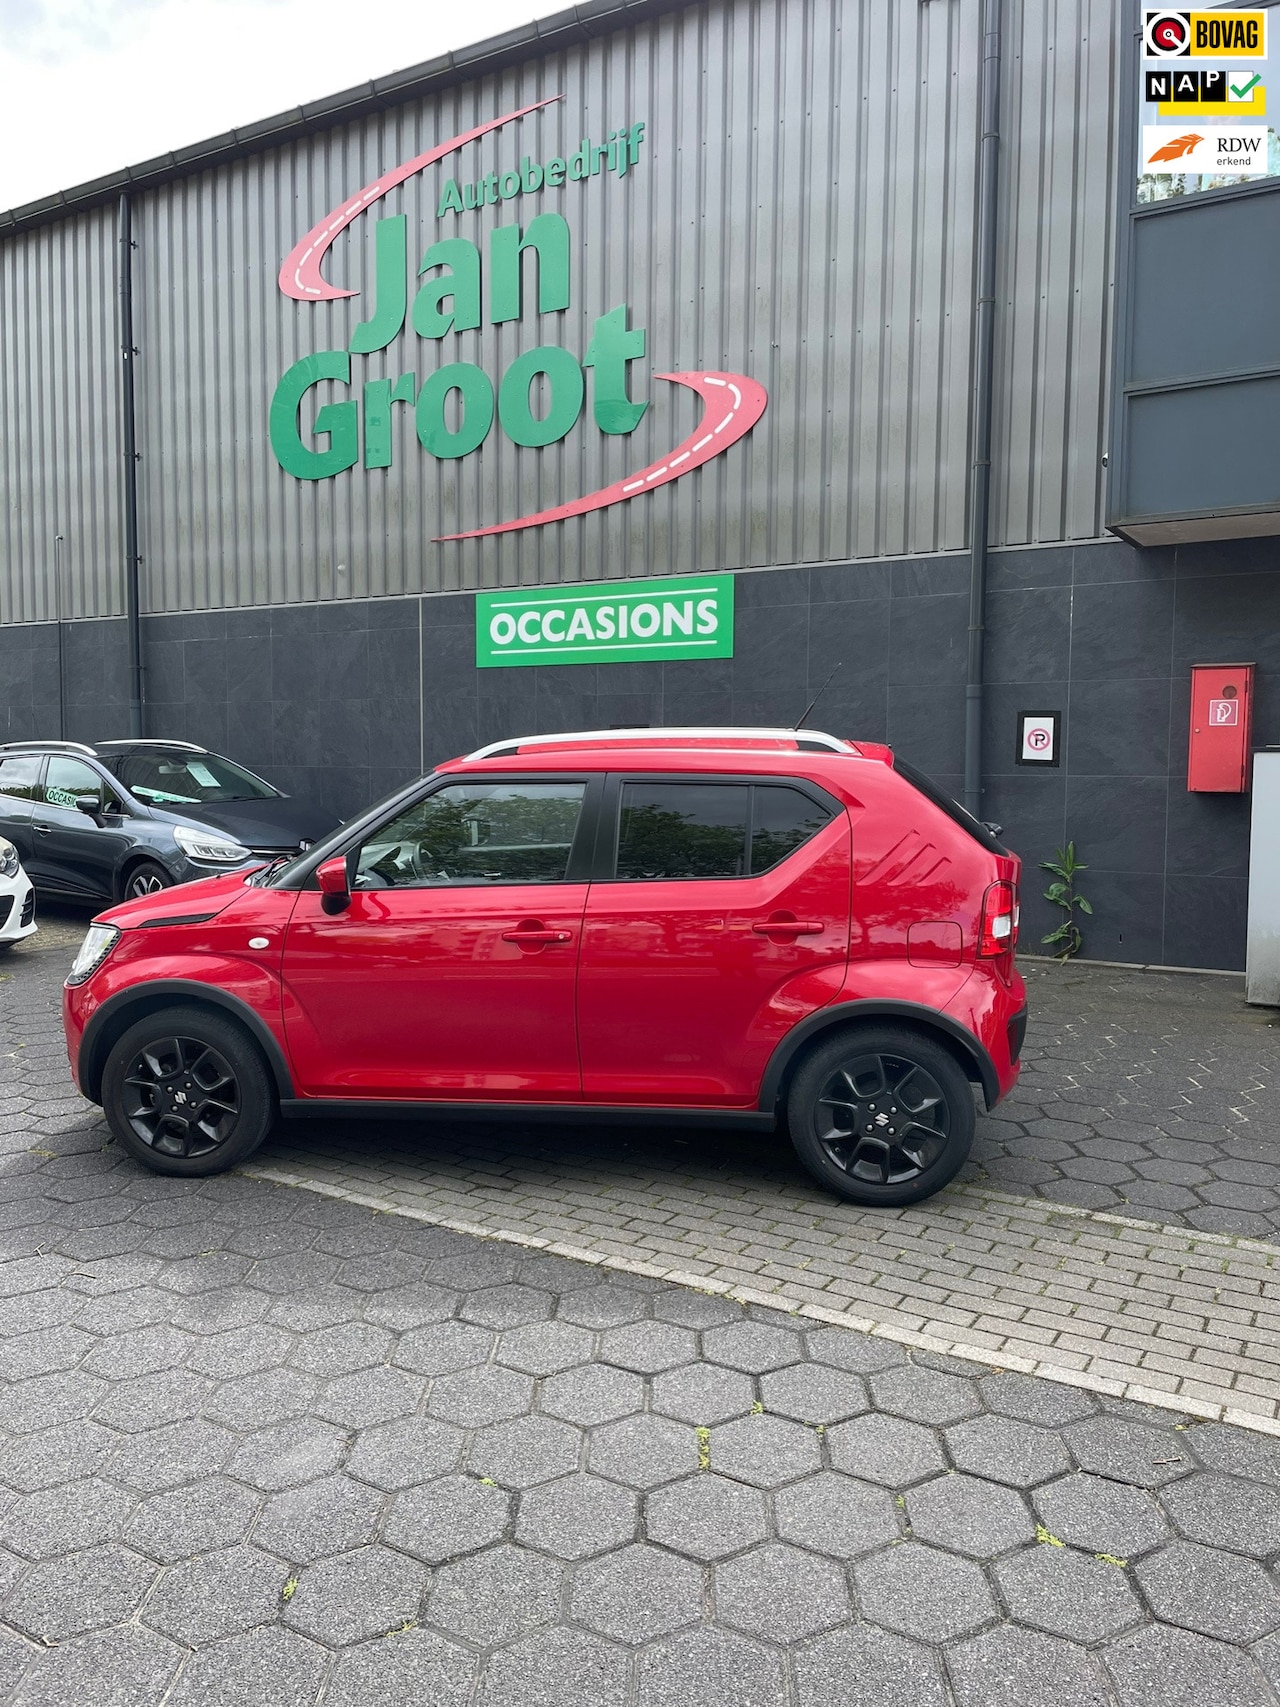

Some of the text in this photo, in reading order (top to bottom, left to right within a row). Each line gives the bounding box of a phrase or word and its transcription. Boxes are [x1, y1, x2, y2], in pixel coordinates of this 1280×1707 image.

[437, 122, 645, 218] Autobedrijf
[349, 213, 570, 354] Jan
[269, 303, 649, 480] Groot
[490, 599, 718, 645] OCCASIONS
